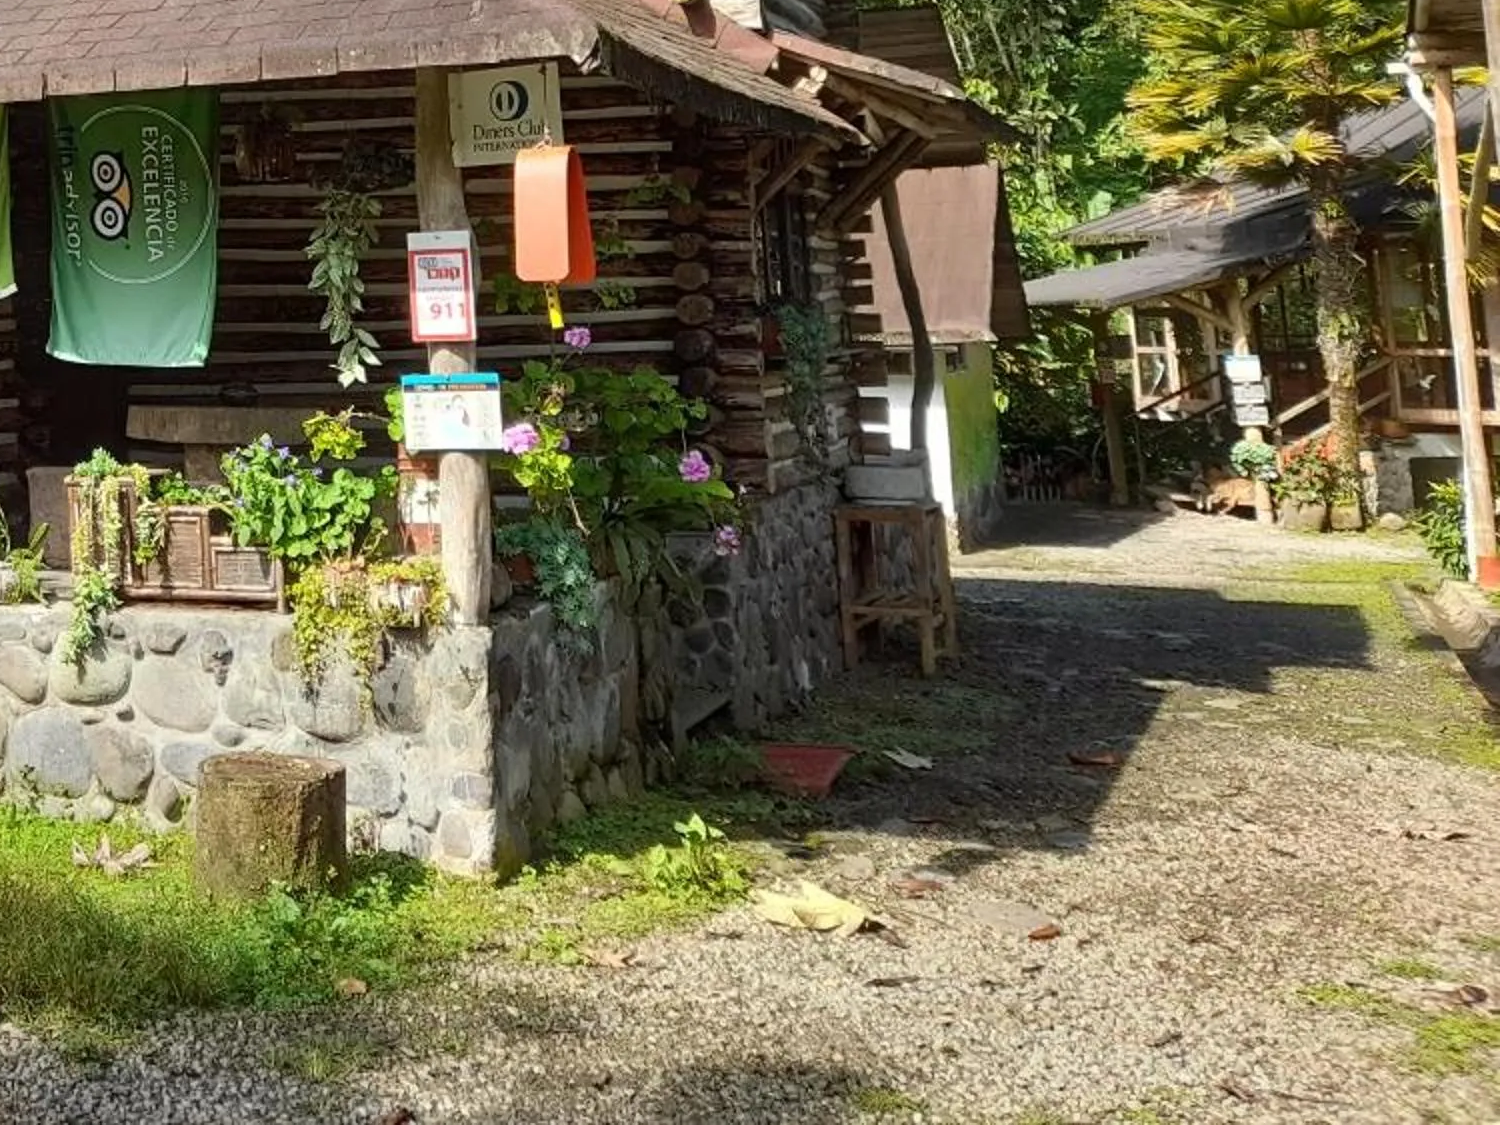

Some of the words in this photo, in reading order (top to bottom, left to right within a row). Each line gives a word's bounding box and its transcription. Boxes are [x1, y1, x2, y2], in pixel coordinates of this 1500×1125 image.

[473, 124, 515, 141] Diners
[141, 126, 164, 262] EXCELENCIA
[161, 134, 179, 232] CERTIFICADO
[429, 302, 465, 319] 911
